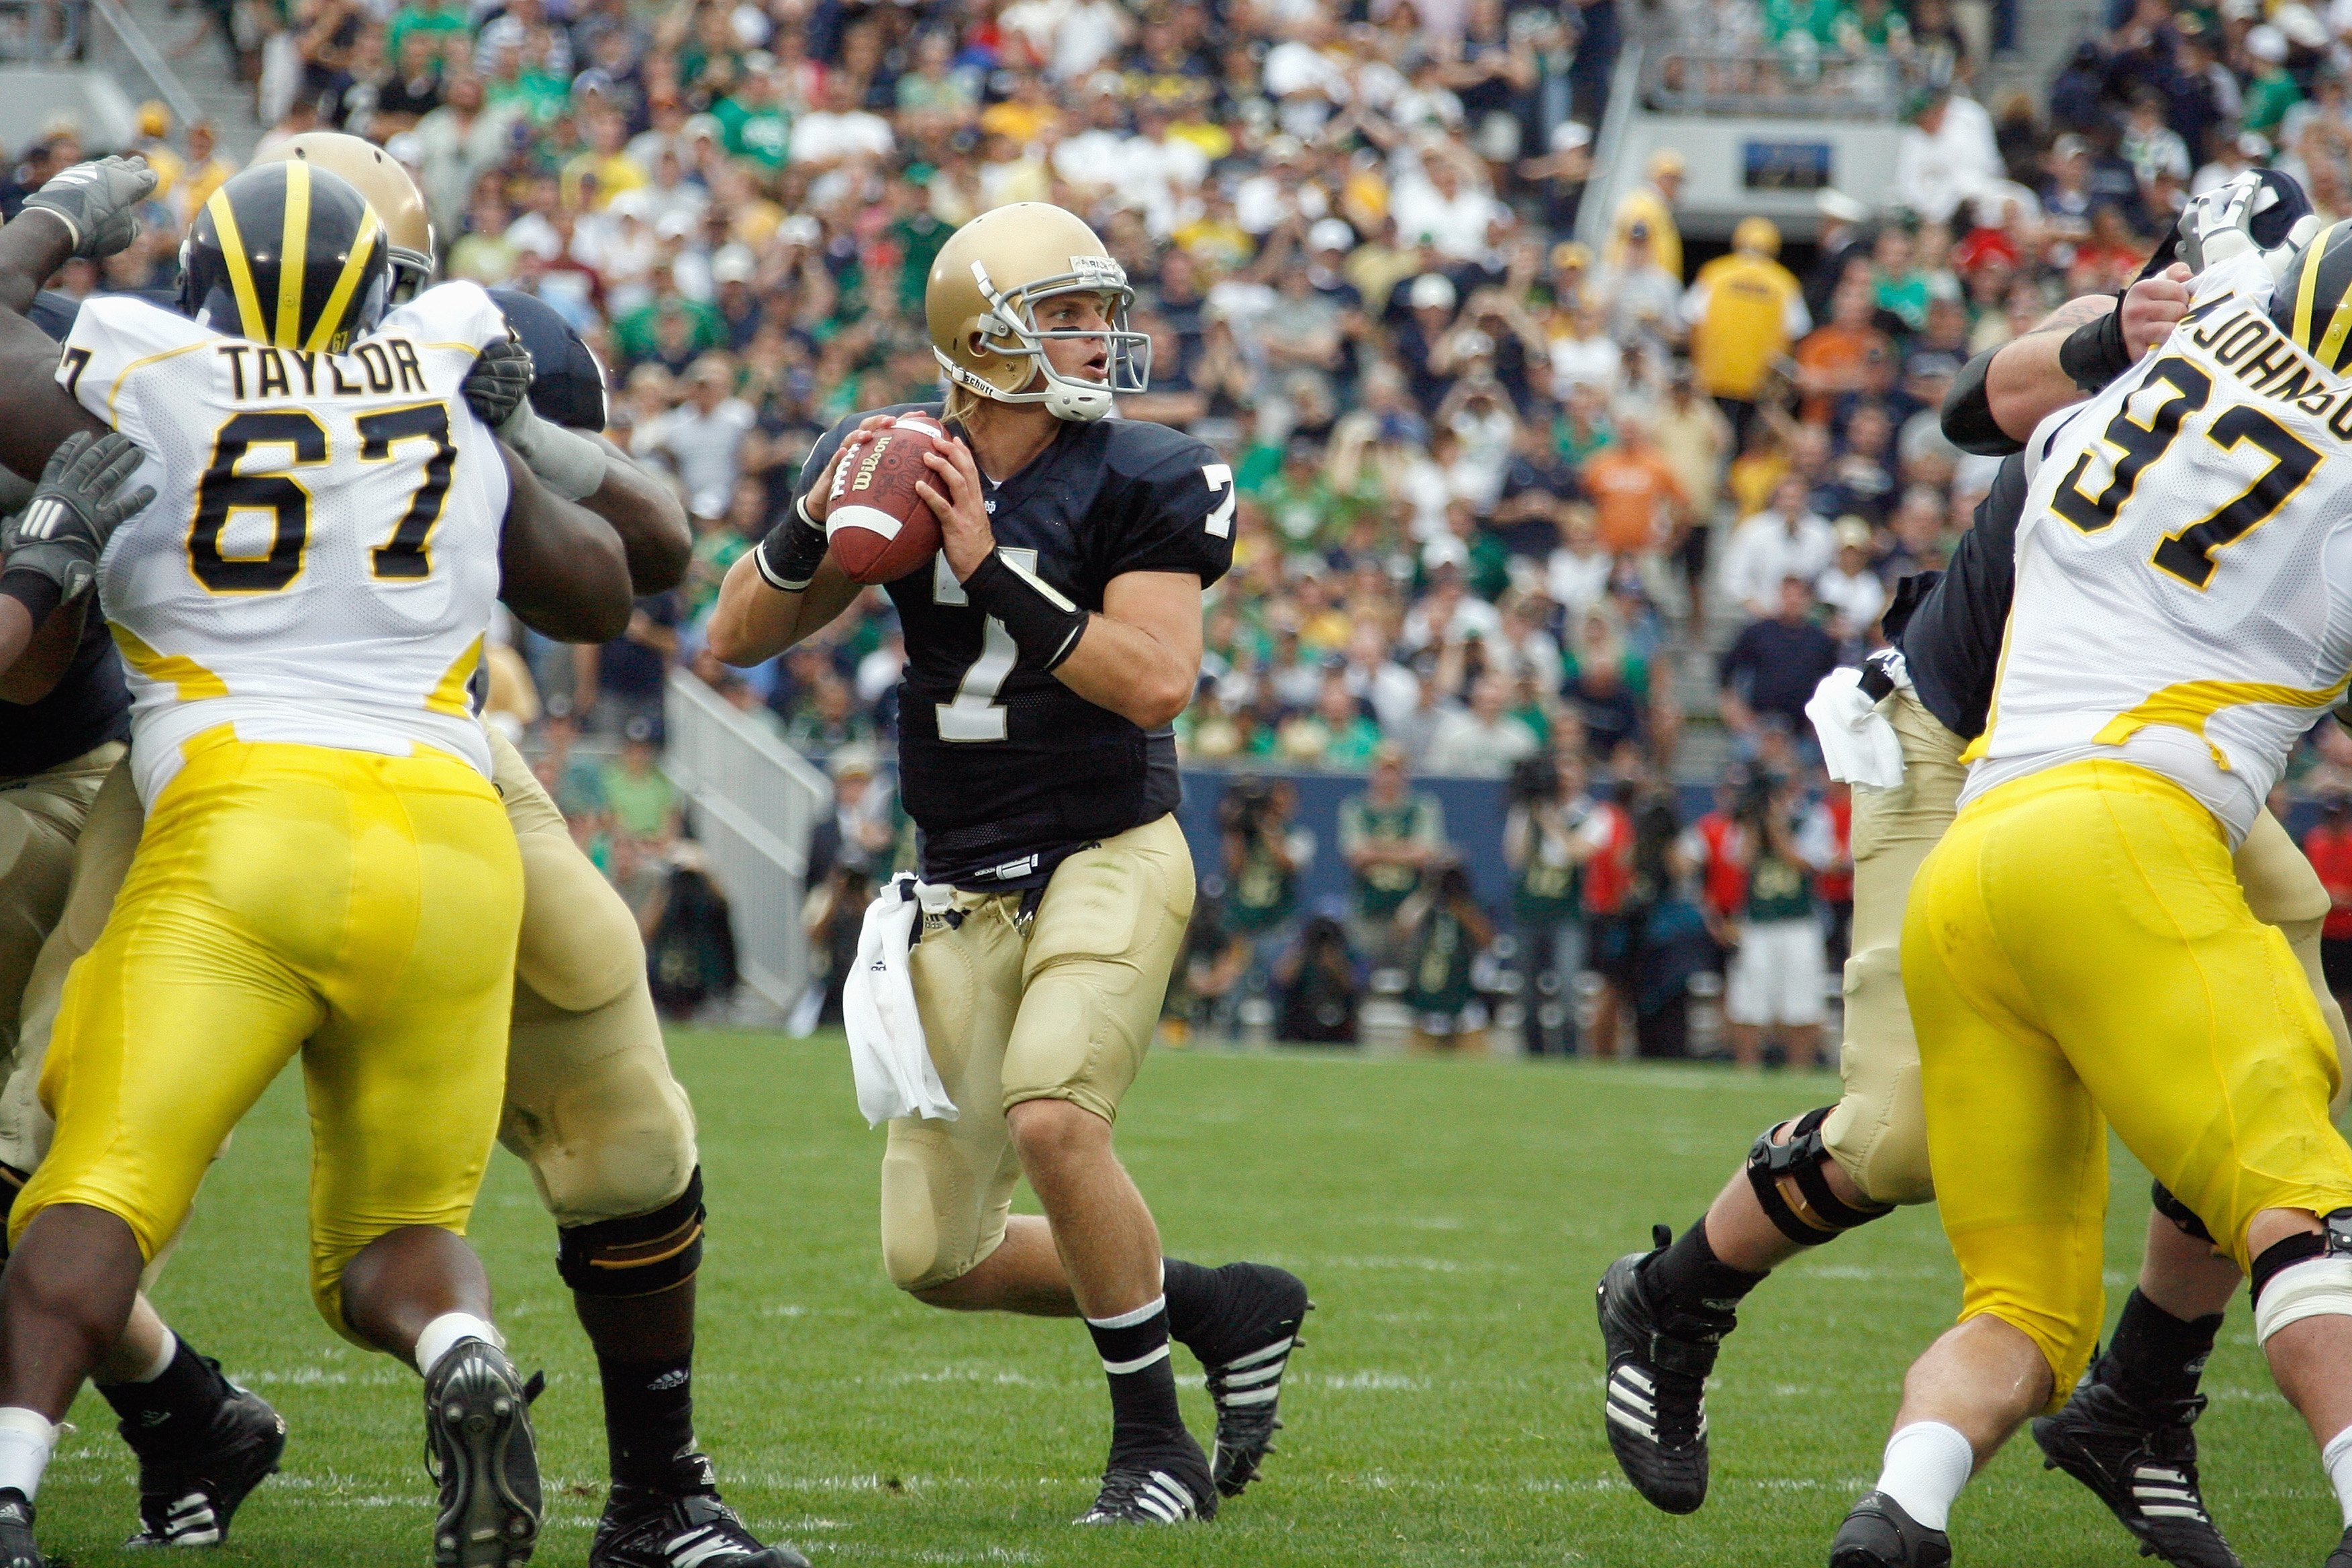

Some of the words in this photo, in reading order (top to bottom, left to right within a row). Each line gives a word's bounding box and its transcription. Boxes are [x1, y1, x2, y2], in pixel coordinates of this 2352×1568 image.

[217, 338, 430, 400] TAYLOR
[332, 331, 348, 353] 67
[964, 374, 994, 396] schutt
[852, 436, 892, 491] Wilson
[2049, 354, 2331, 592] 97
[186, 400, 458, 597] 67
[1201, 463, 1236, 540] 7
[934, 546, 1038, 742] 7
